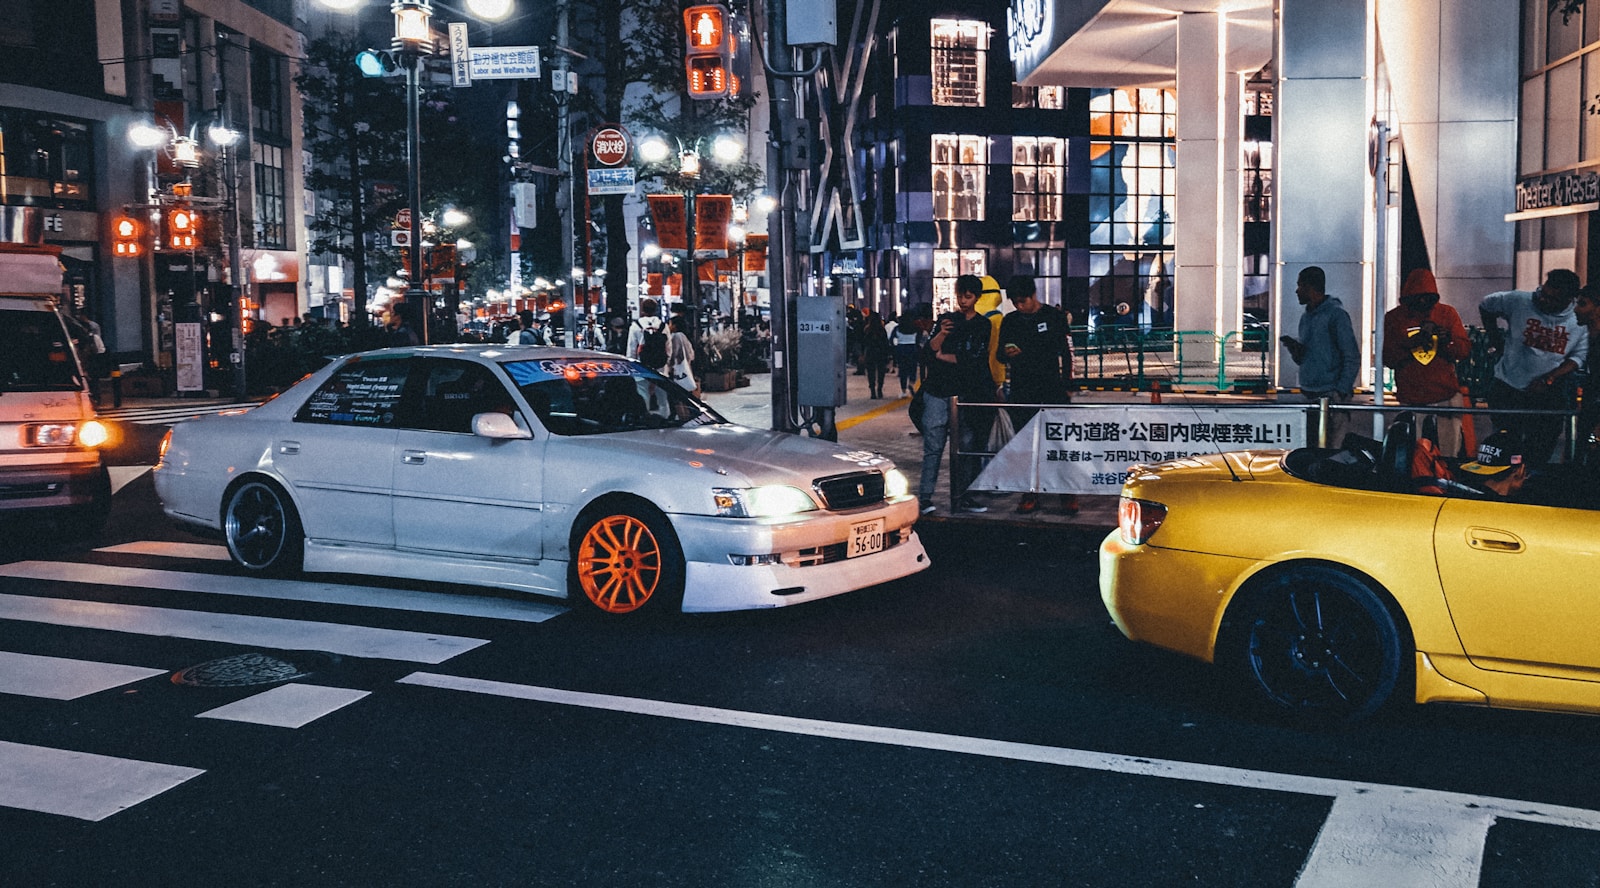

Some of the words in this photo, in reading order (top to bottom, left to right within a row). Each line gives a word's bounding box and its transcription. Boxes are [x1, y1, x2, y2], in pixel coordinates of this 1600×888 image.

[503, 66, 525, 74] Welfare
[596, 139, 624, 154] 消火栓
[1516, 181, 1553, 211] Theater
[856, 533, 880, 553] 56-00
